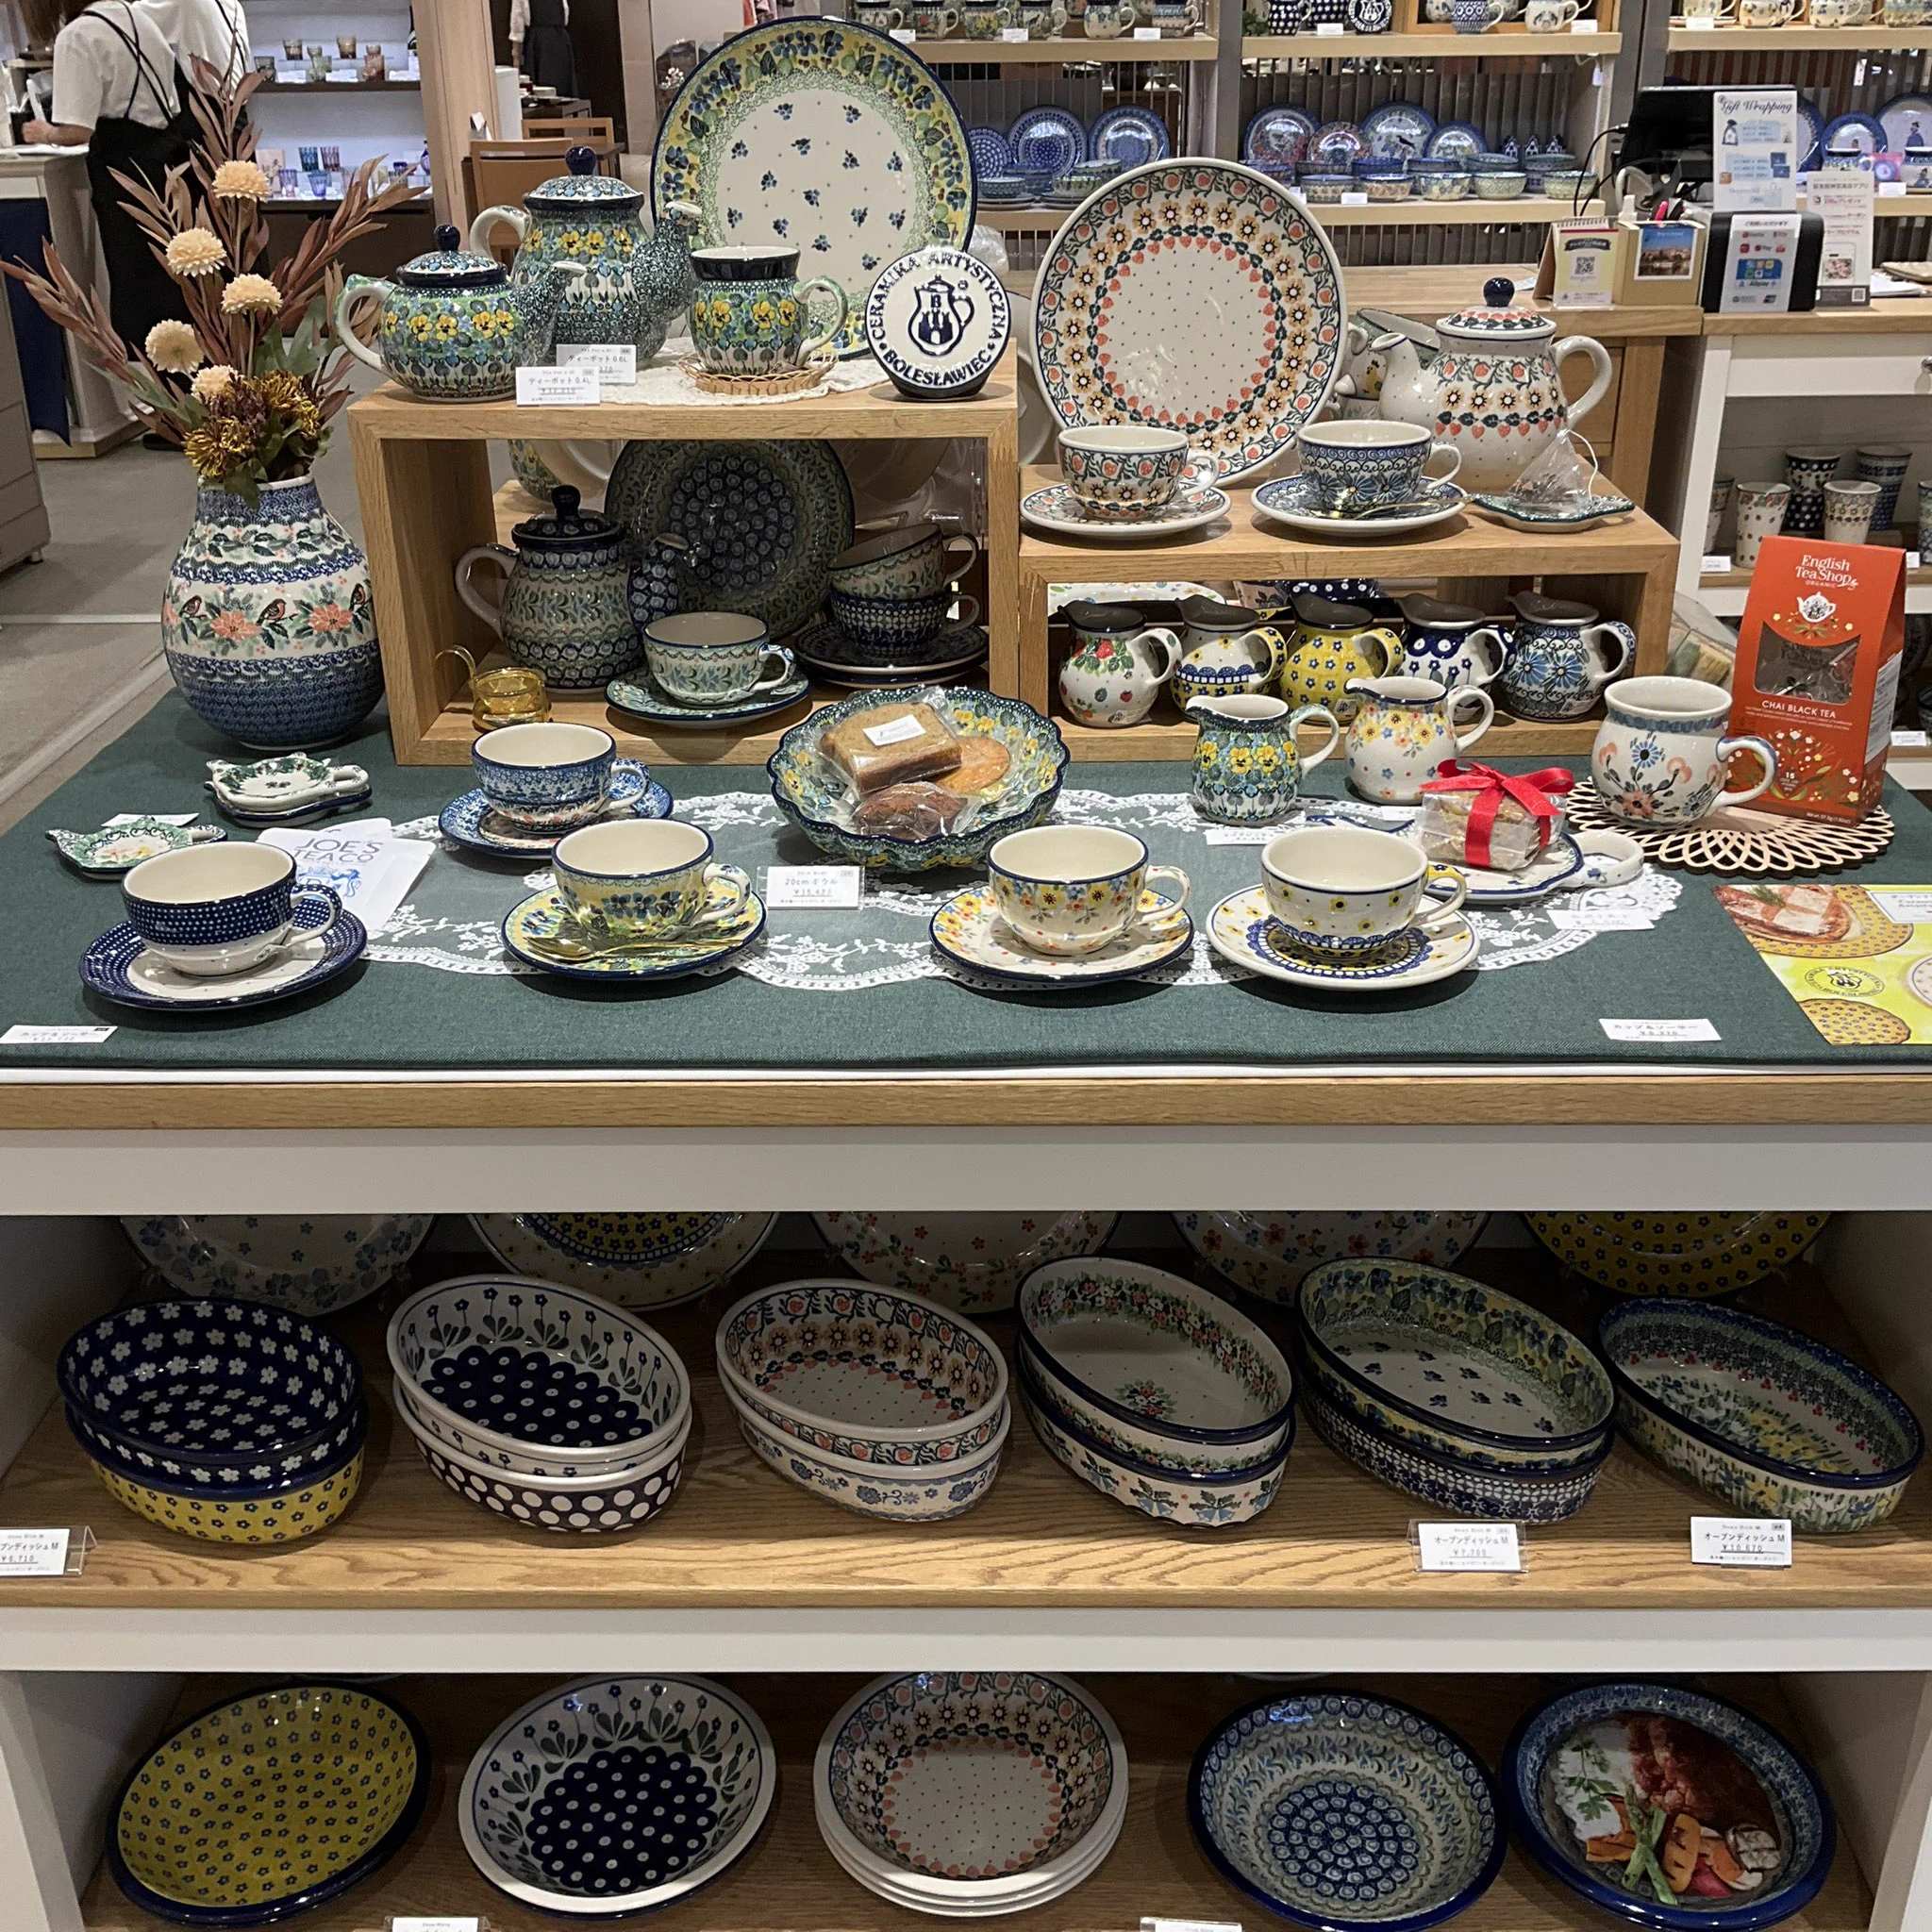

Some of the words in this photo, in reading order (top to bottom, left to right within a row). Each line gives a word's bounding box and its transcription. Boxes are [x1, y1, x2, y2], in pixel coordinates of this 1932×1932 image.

[1720, 99, 1740, 115] Gift
[1742, 99, 1793, 115] Wrapping
[870, 257, 921, 340] CERAMIKA
[927, 252, 1006, 340] ARTYSTYCZNA
[883, 348, 992, 386] BOLESŁAWIEC
[1801, 554, 1851, 572] English
[1795, 566, 1818, 580] Tea
[1818, 568, 1854, 588] Shop
[1805, 579, 1837, 589] ORGANIC
[1761, 700, 1786, 710] CHAI
[1787, 705, 1818, 716] BLACK
[1820, 708, 1837, 719] TEA
[295, 838, 385, 854] JOE'S
[293, 848, 334, 861] TEA
[339, 853, 375, 863] CO
[785, 877, 809, 886] 20cm
